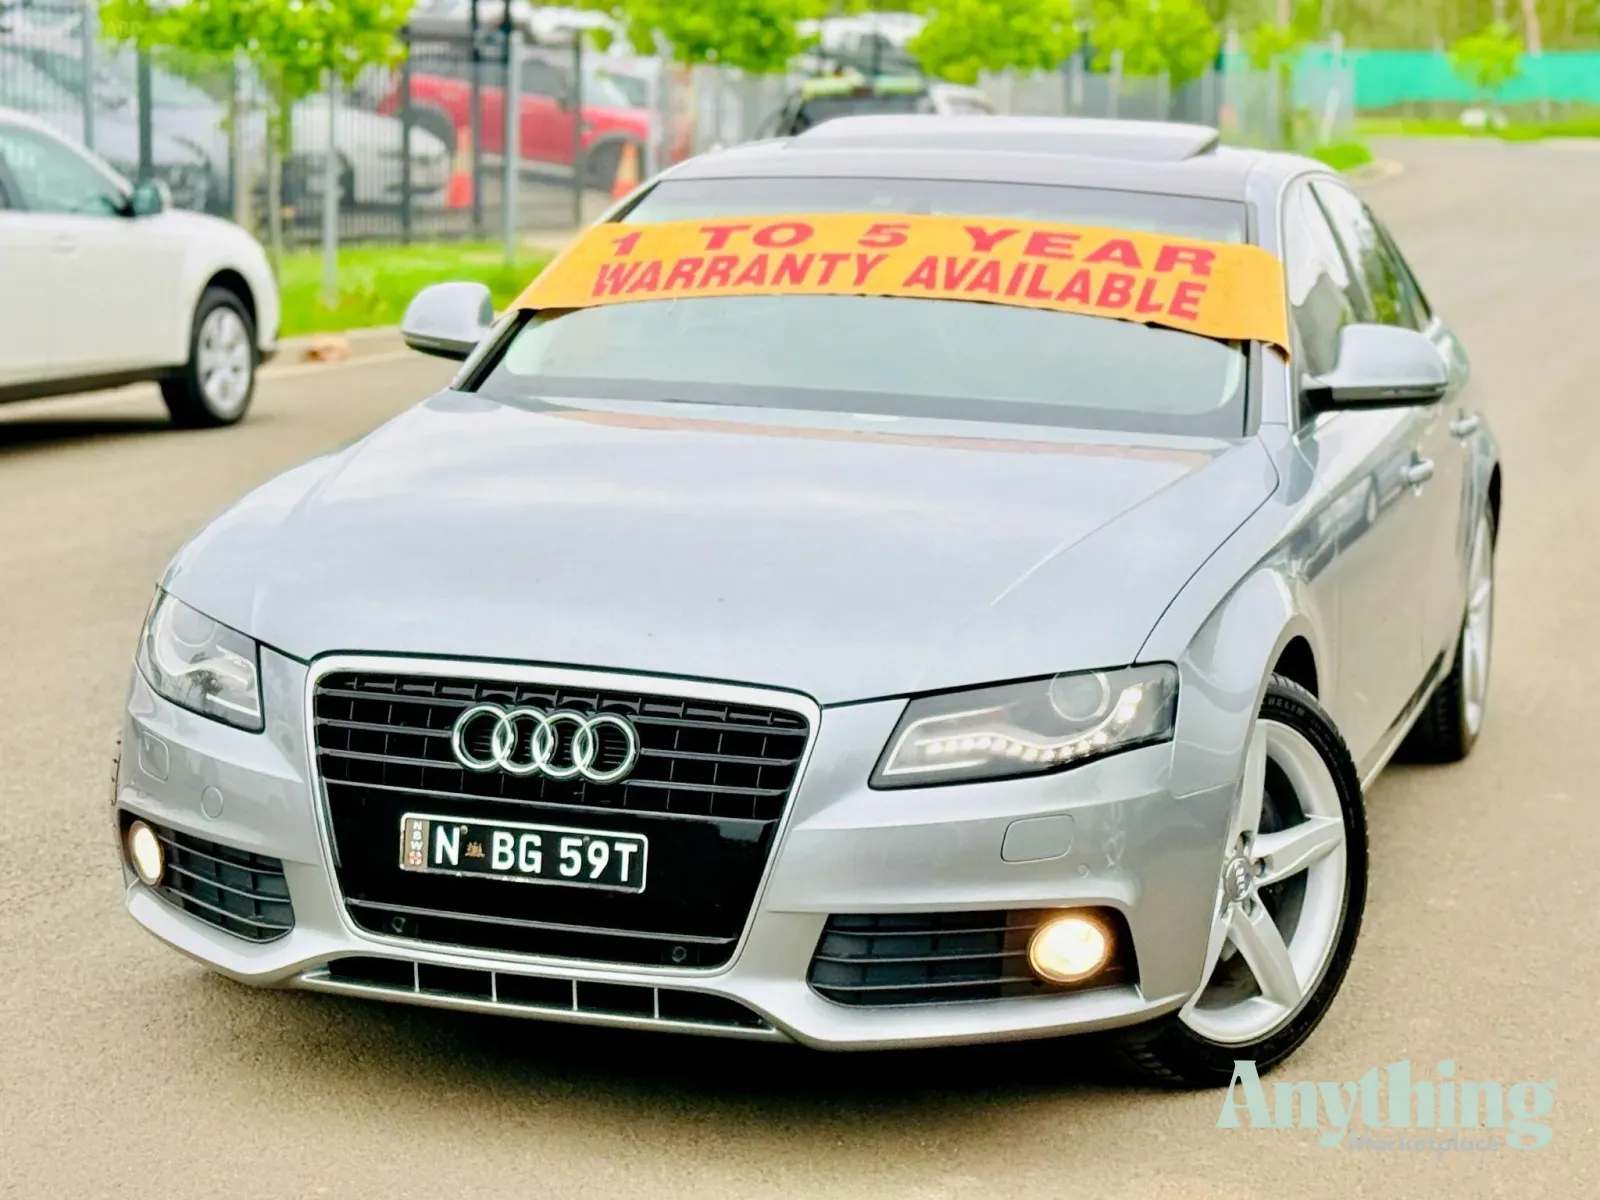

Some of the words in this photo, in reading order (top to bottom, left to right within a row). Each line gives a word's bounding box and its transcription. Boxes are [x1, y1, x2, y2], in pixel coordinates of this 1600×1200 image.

[611, 231, 642, 256] 1
[700, 222, 815, 250] TO
[858, 223, 911, 248] 5
[962, 225, 1217, 277] YEAR
[591, 253, 889, 298] WARRANTY
[902, 255, 1207, 322] AVAILABLE
[435, 825, 460, 866] N
[491, 830, 542, 874] BG
[559, 836, 638, 882] 59T
